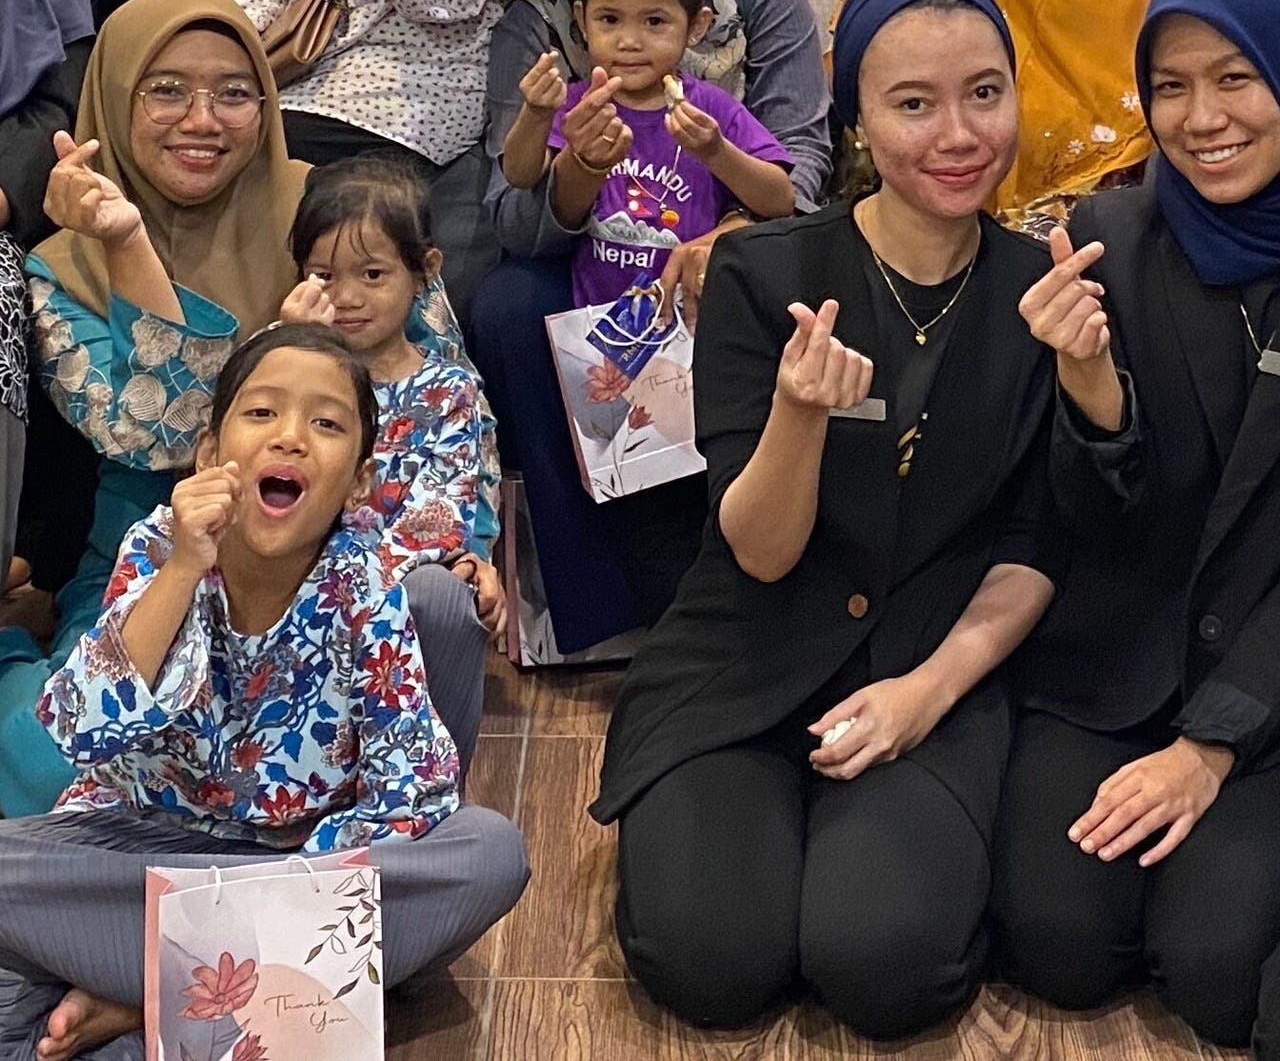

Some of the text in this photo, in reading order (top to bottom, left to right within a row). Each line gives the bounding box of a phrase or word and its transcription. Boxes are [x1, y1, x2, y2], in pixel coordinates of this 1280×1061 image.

[593, 238, 656, 269] Nepal
[264, 993, 332, 1017] Thank
[310, 1011, 349, 1033] You
